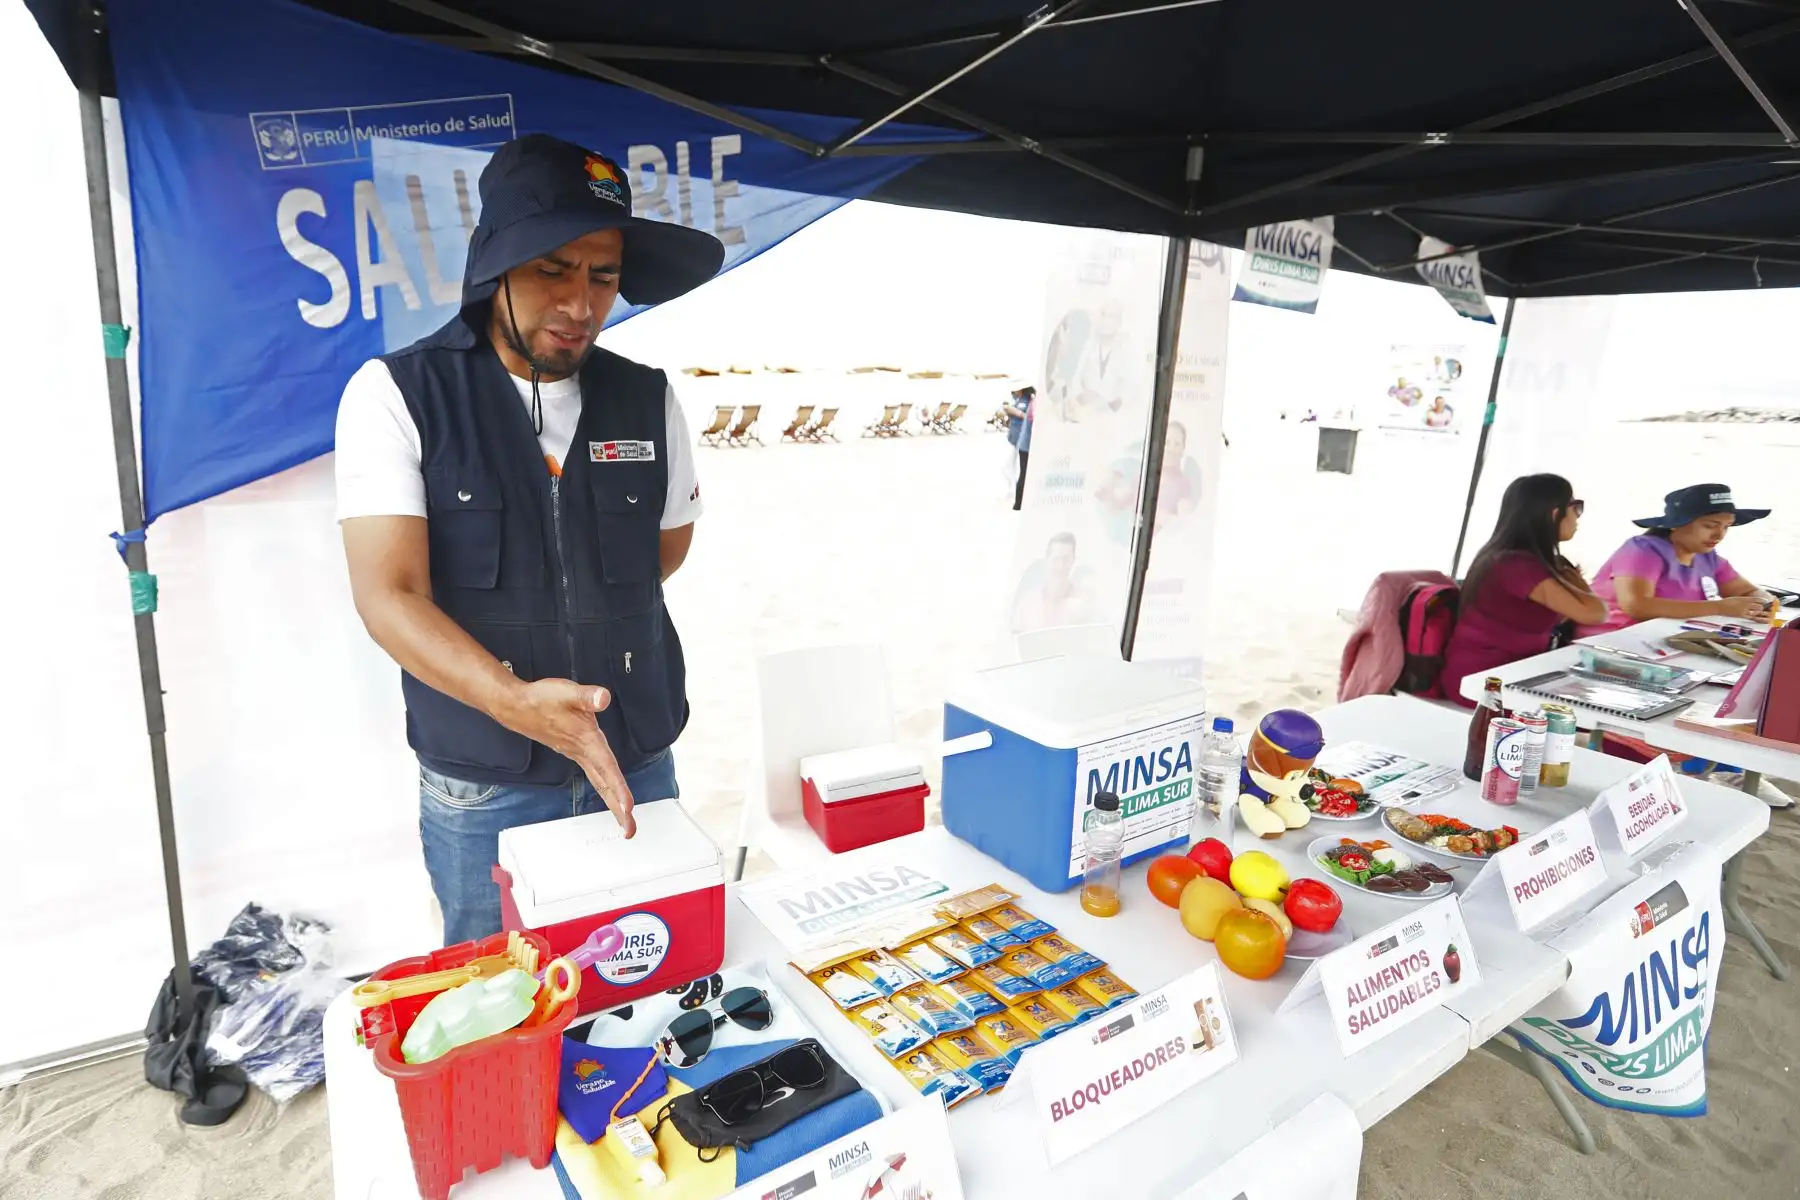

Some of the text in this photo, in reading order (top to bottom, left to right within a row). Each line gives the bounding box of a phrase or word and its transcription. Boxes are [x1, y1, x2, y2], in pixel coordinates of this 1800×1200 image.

[303, 112, 511, 148] PERÚ Ministerio de Salud
[1254, 222, 1322, 264] MINSA
[1086, 740, 1193, 806] MINSA
[1127, 780, 1189, 815] LIMA SUR
[1627, 792, 1657, 819] BEBIDAS
[777, 865, 932, 920] MINSA
[1513, 845, 1595, 904] PROHIBICIONES
[624, 932, 656, 950] IRIS
[1401, 920, 1423, 938] MINSA
[636, 945, 664, 960] SUR
[1346, 949, 1431, 1009] ALIMENTOS
[1556, 910, 1710, 1047] MINSA
[1140, 994, 1168, 1015] MINSA
[1347, 970, 1441, 1036] SALUDABLES
[1653, 1018, 1698, 1074] LIMA
[575, 1078, 605, 1091] Verano
[1050, 1035, 1186, 1123] BLOQUEADORES
[828, 1140, 870, 1171] MINSA
